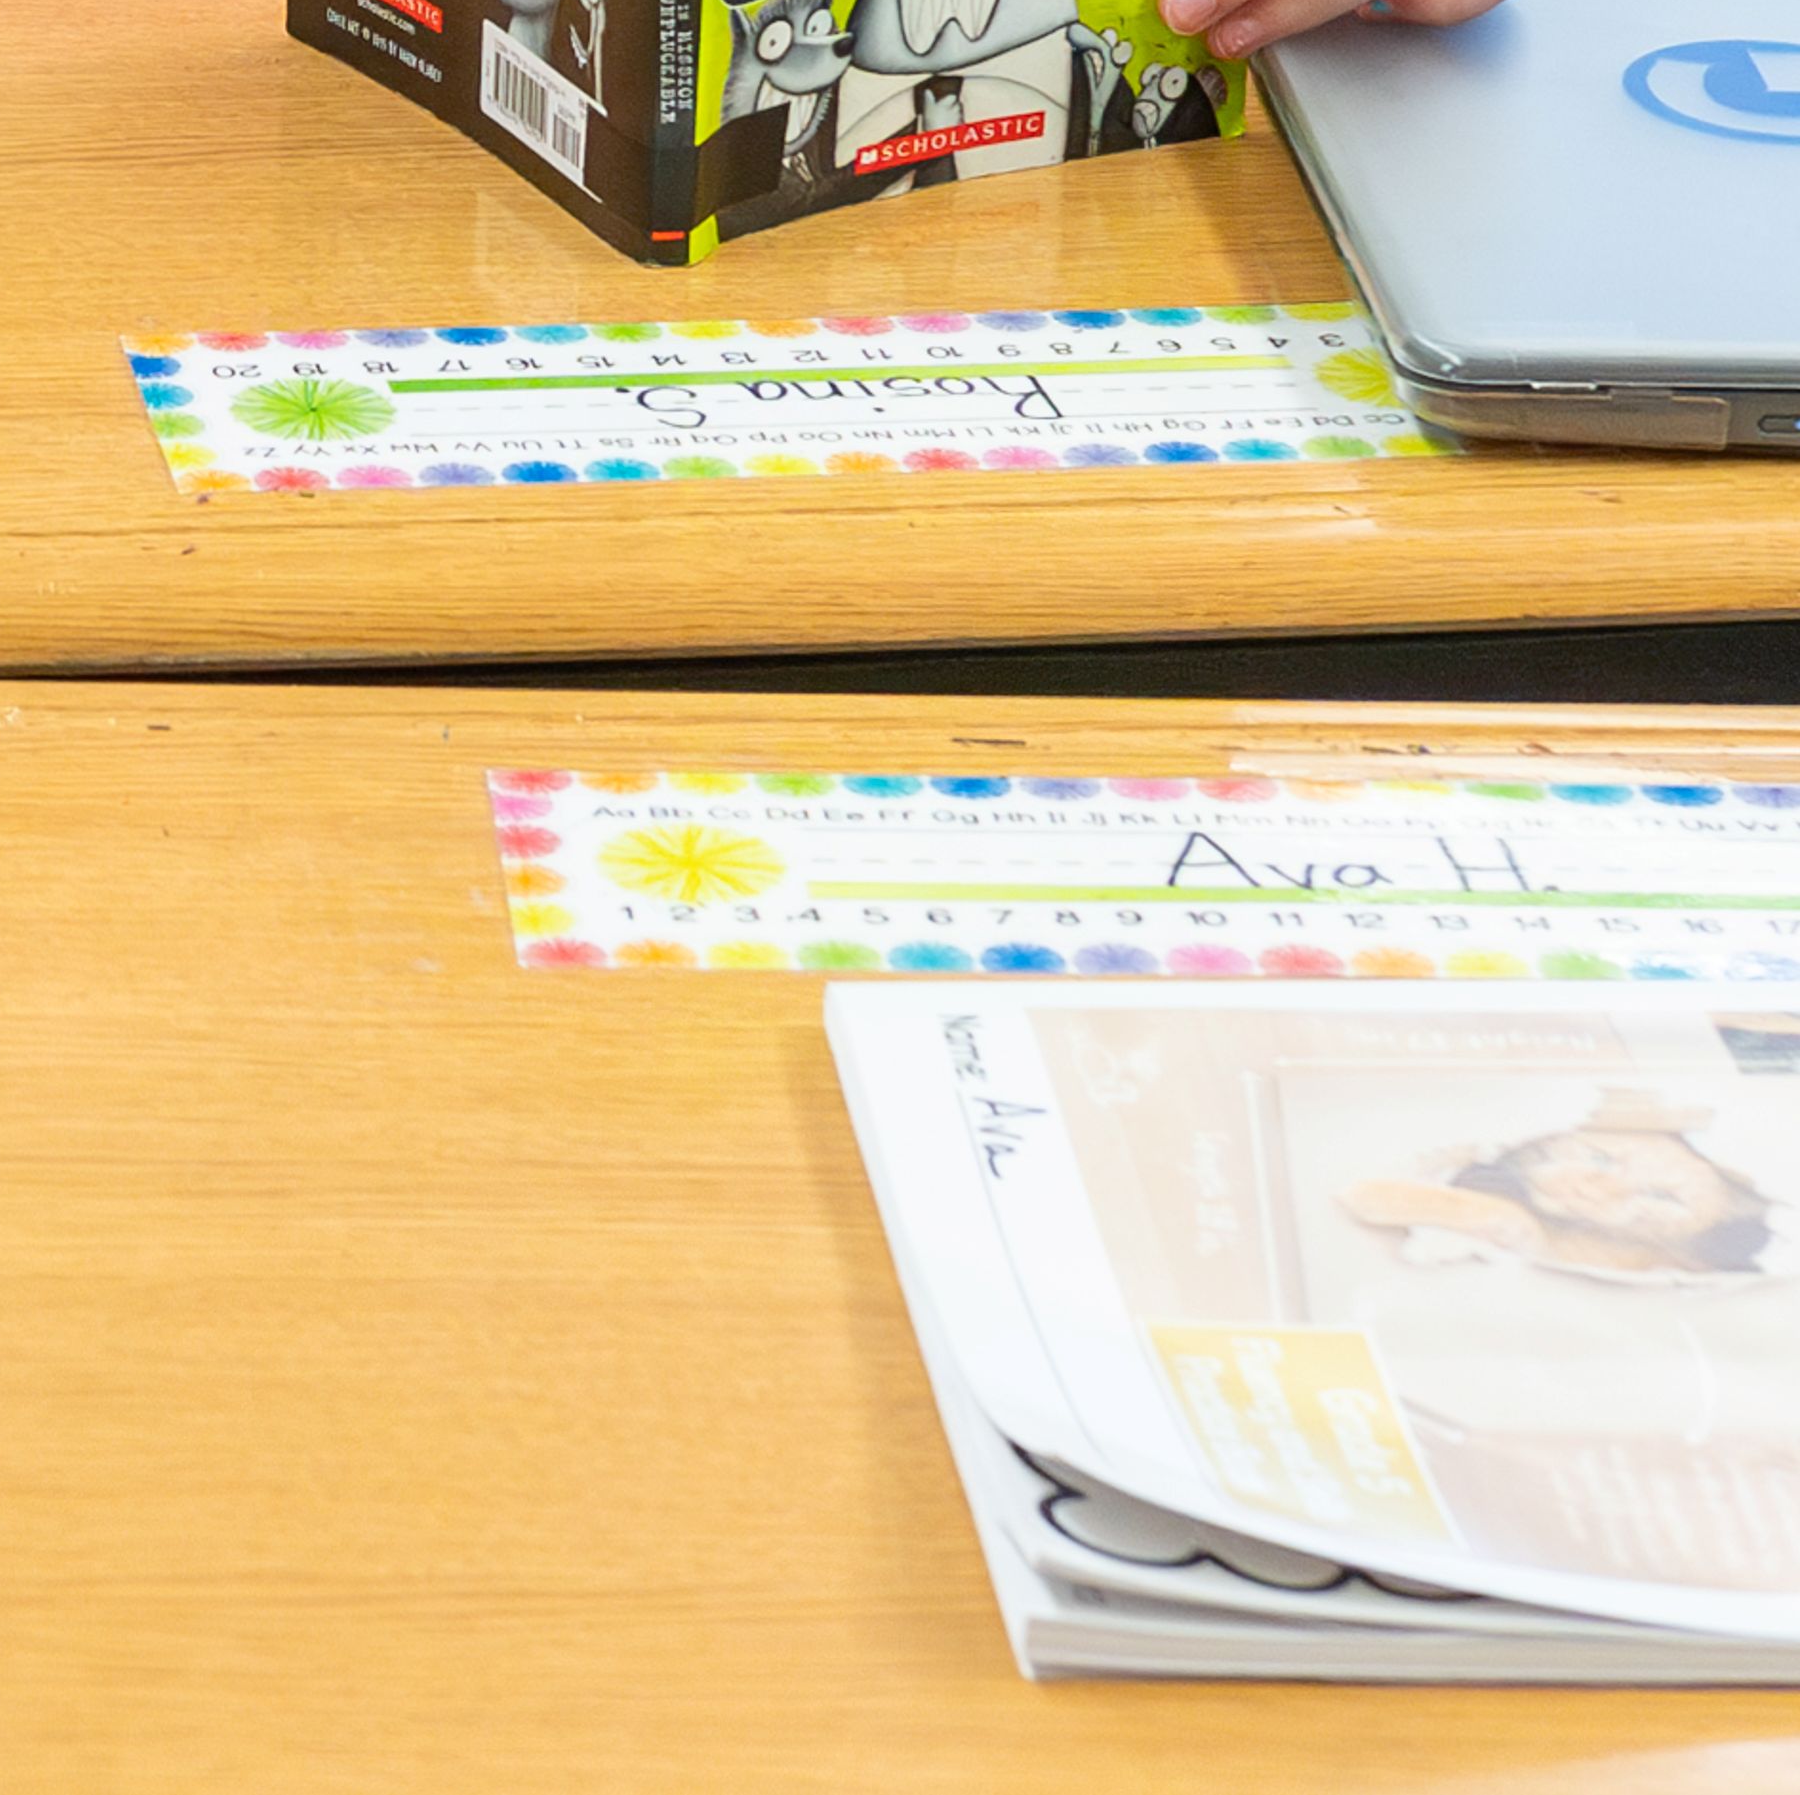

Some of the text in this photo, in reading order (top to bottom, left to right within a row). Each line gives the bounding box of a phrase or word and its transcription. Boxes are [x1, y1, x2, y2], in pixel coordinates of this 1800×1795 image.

[880, 115, 1041, 162] SCHOLASTIC
[212, 350, 829, 379] 12 17 19 20
[735, 374, 1066, 421] Rosina
[1167, 831, 1562, 893] Ava H.
[972, 1096, 1048, 1180] Ava
